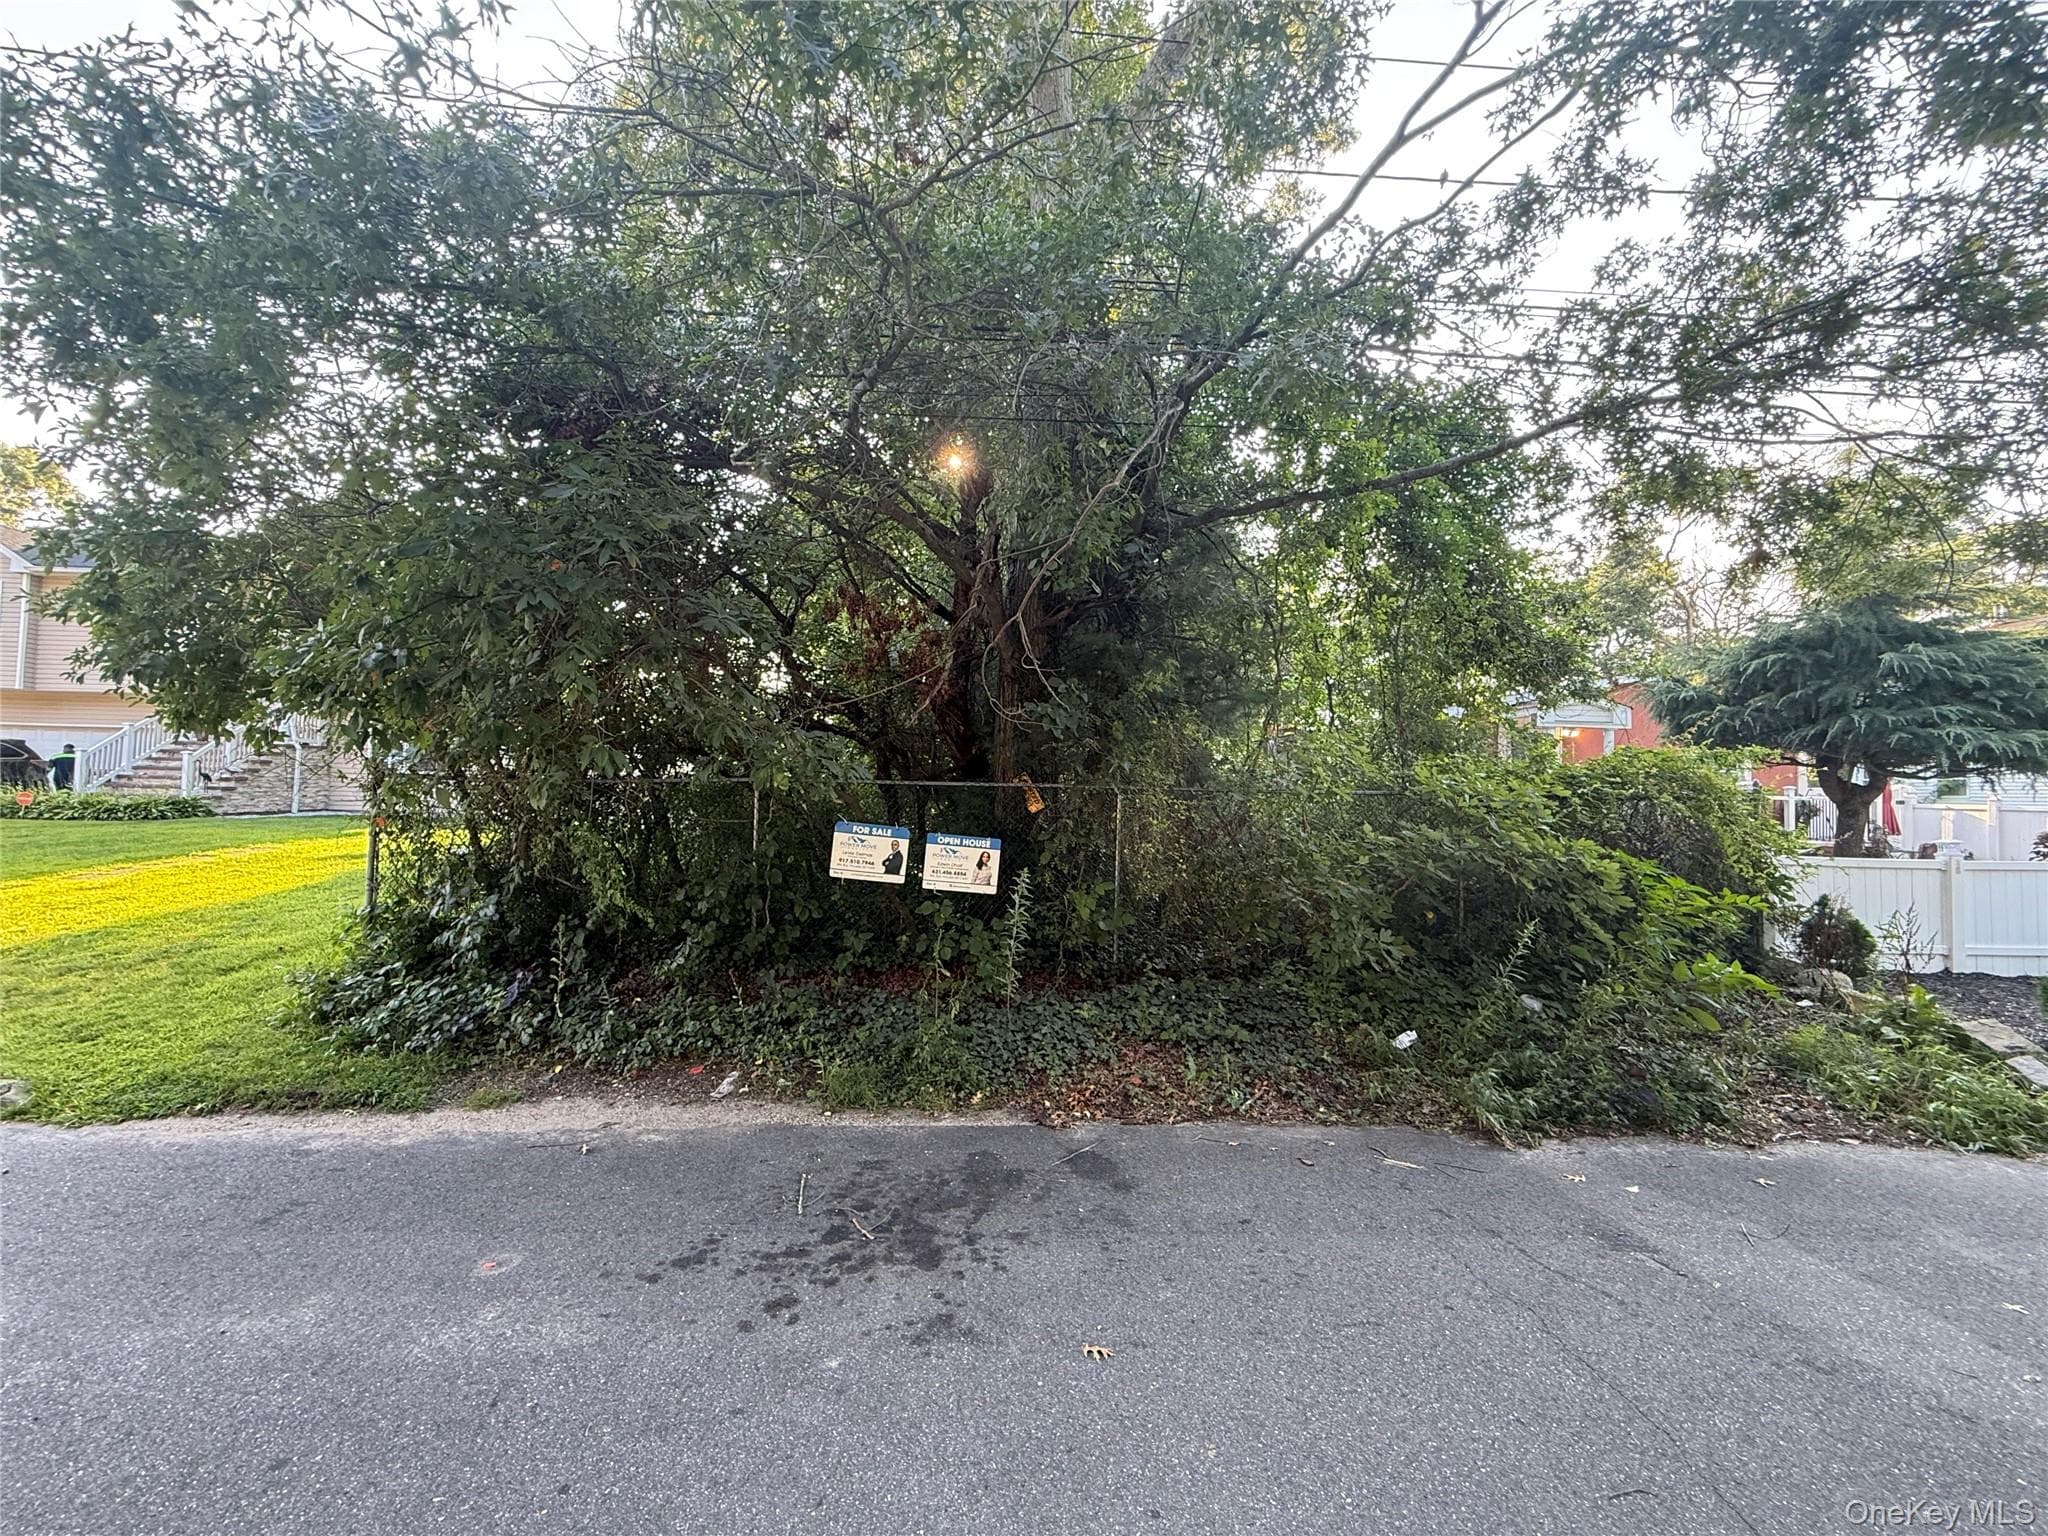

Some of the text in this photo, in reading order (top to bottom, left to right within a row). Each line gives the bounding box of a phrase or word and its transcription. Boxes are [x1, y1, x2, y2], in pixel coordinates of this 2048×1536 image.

[852, 825, 892, 837] FOR SALE
[937, 836, 991, 848] OPEN HOUSE
